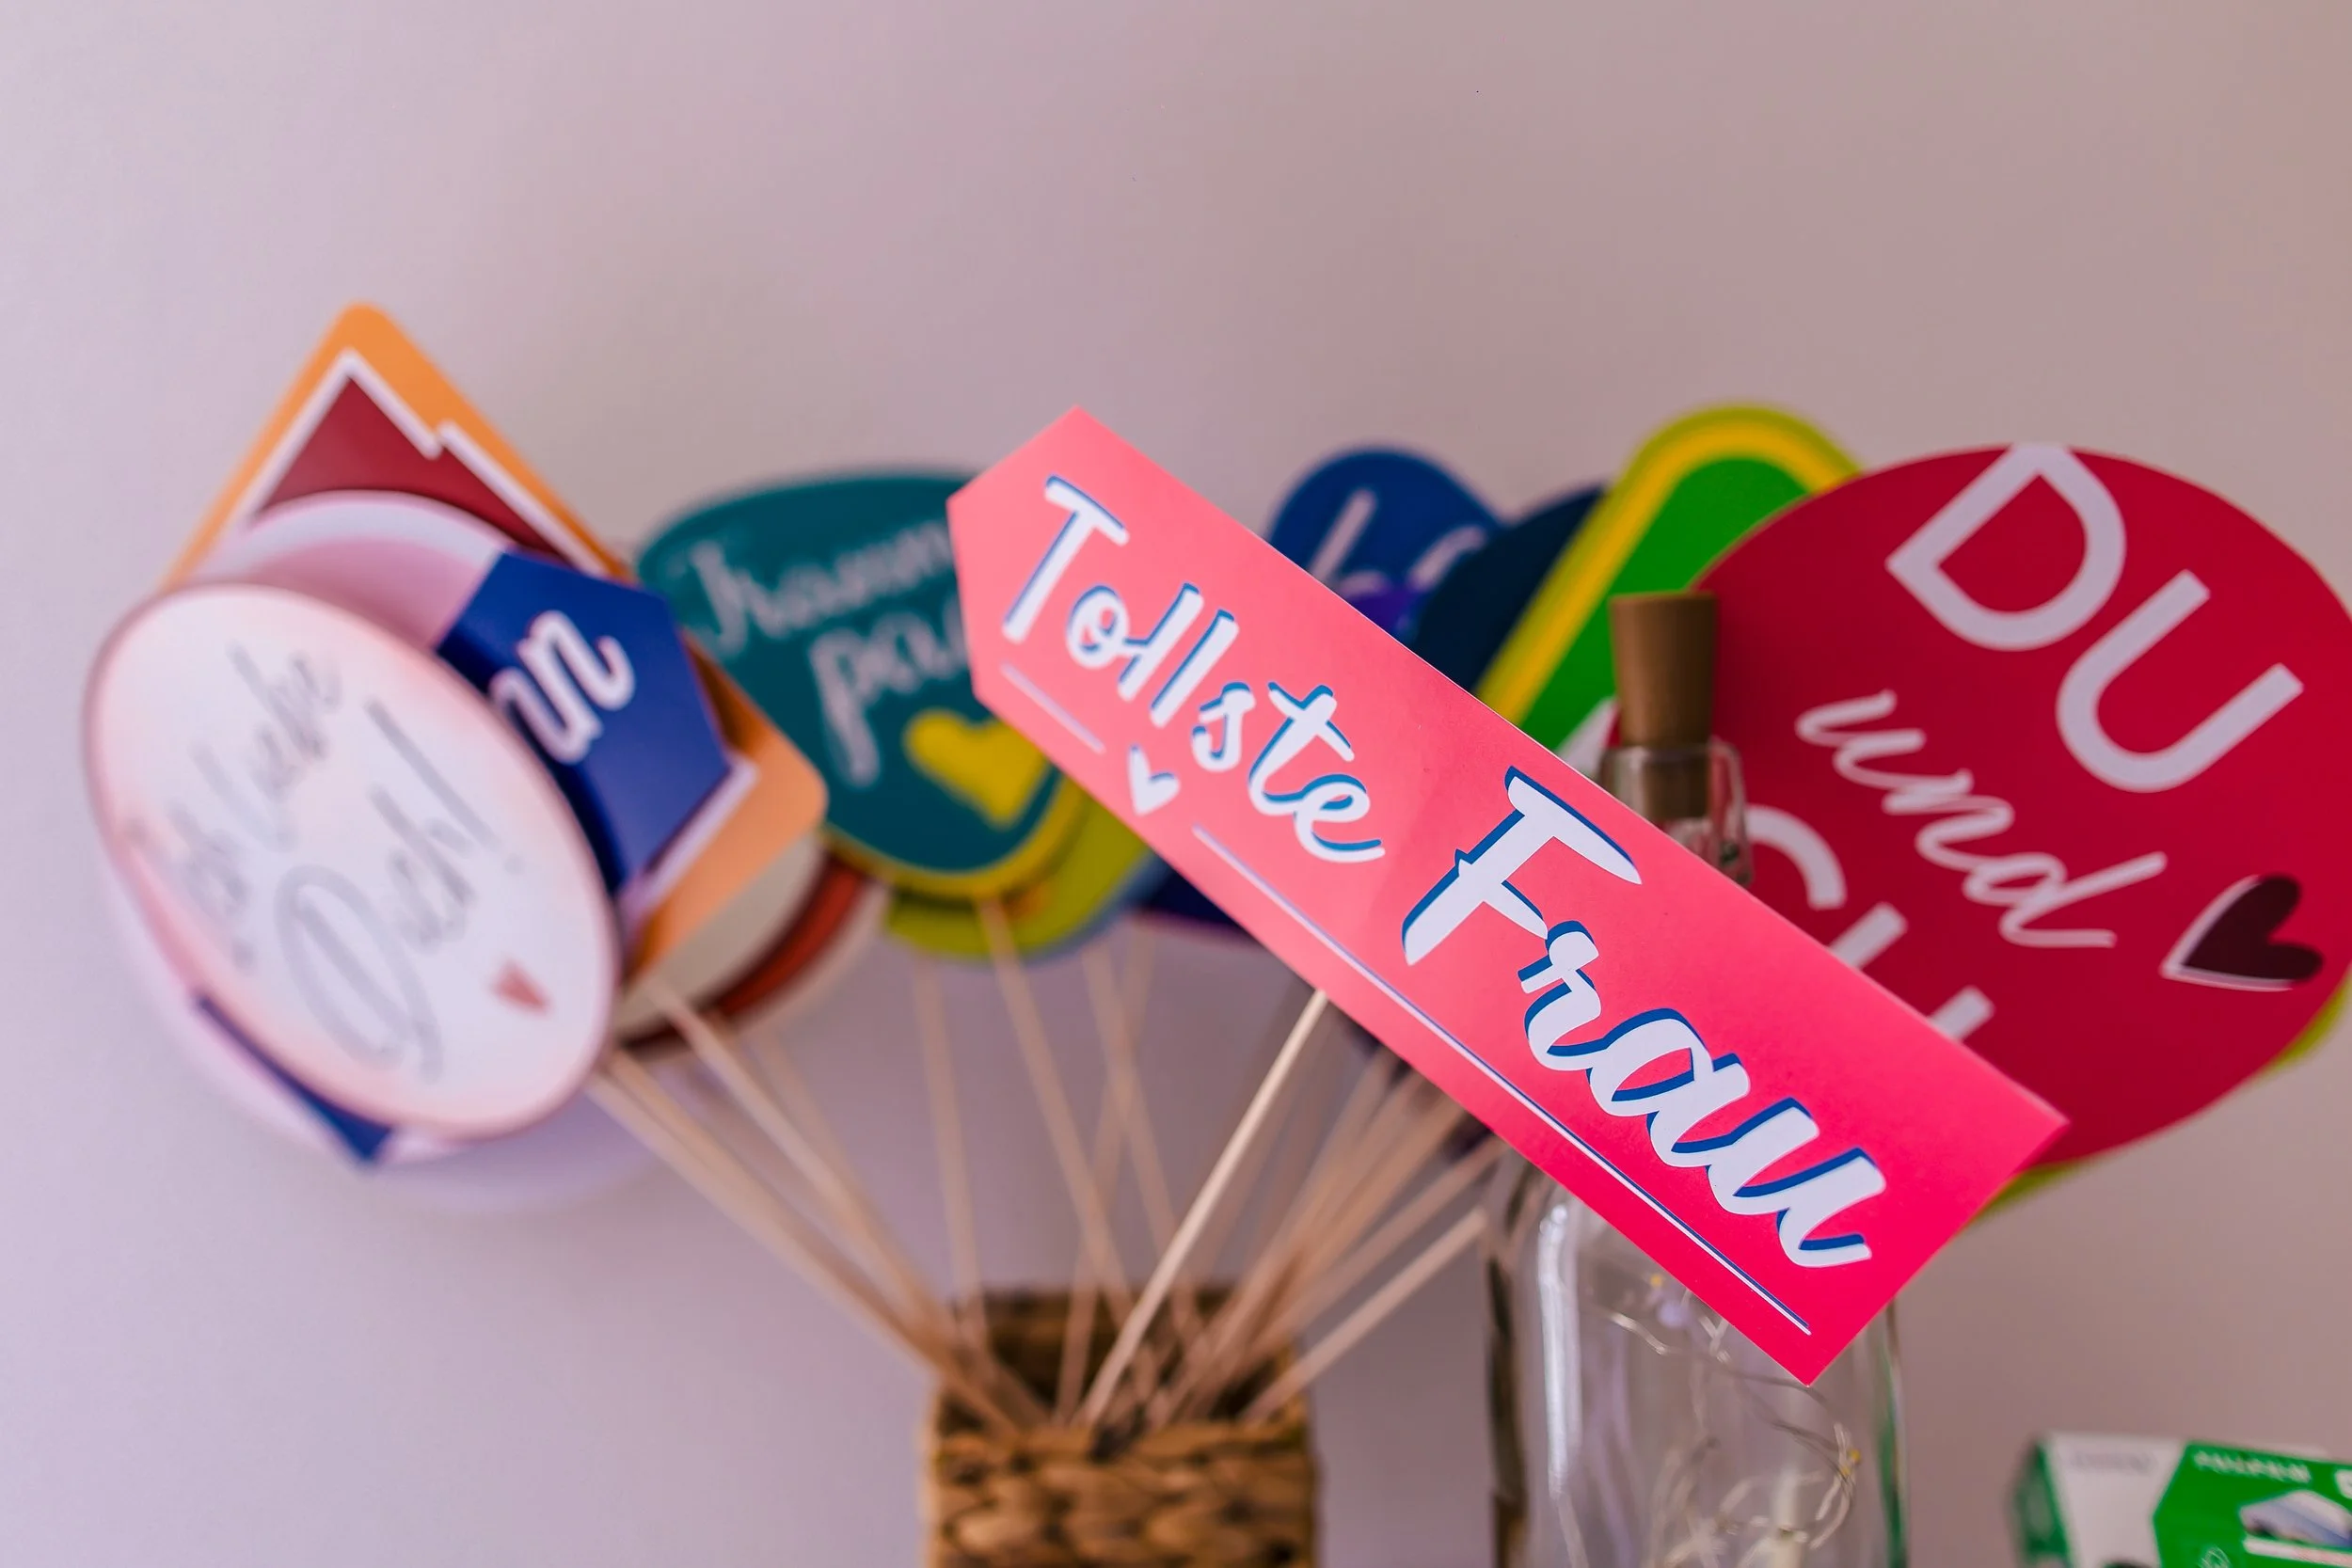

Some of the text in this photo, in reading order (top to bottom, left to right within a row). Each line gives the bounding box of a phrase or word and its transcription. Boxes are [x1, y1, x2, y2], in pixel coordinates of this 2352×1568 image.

[1884, 443, 2305, 794] DU
[1001, 475, 1385, 863] Tollste
[1402, 766, 1886, 1270] Frau
[1795, 689, 2168, 950] und
